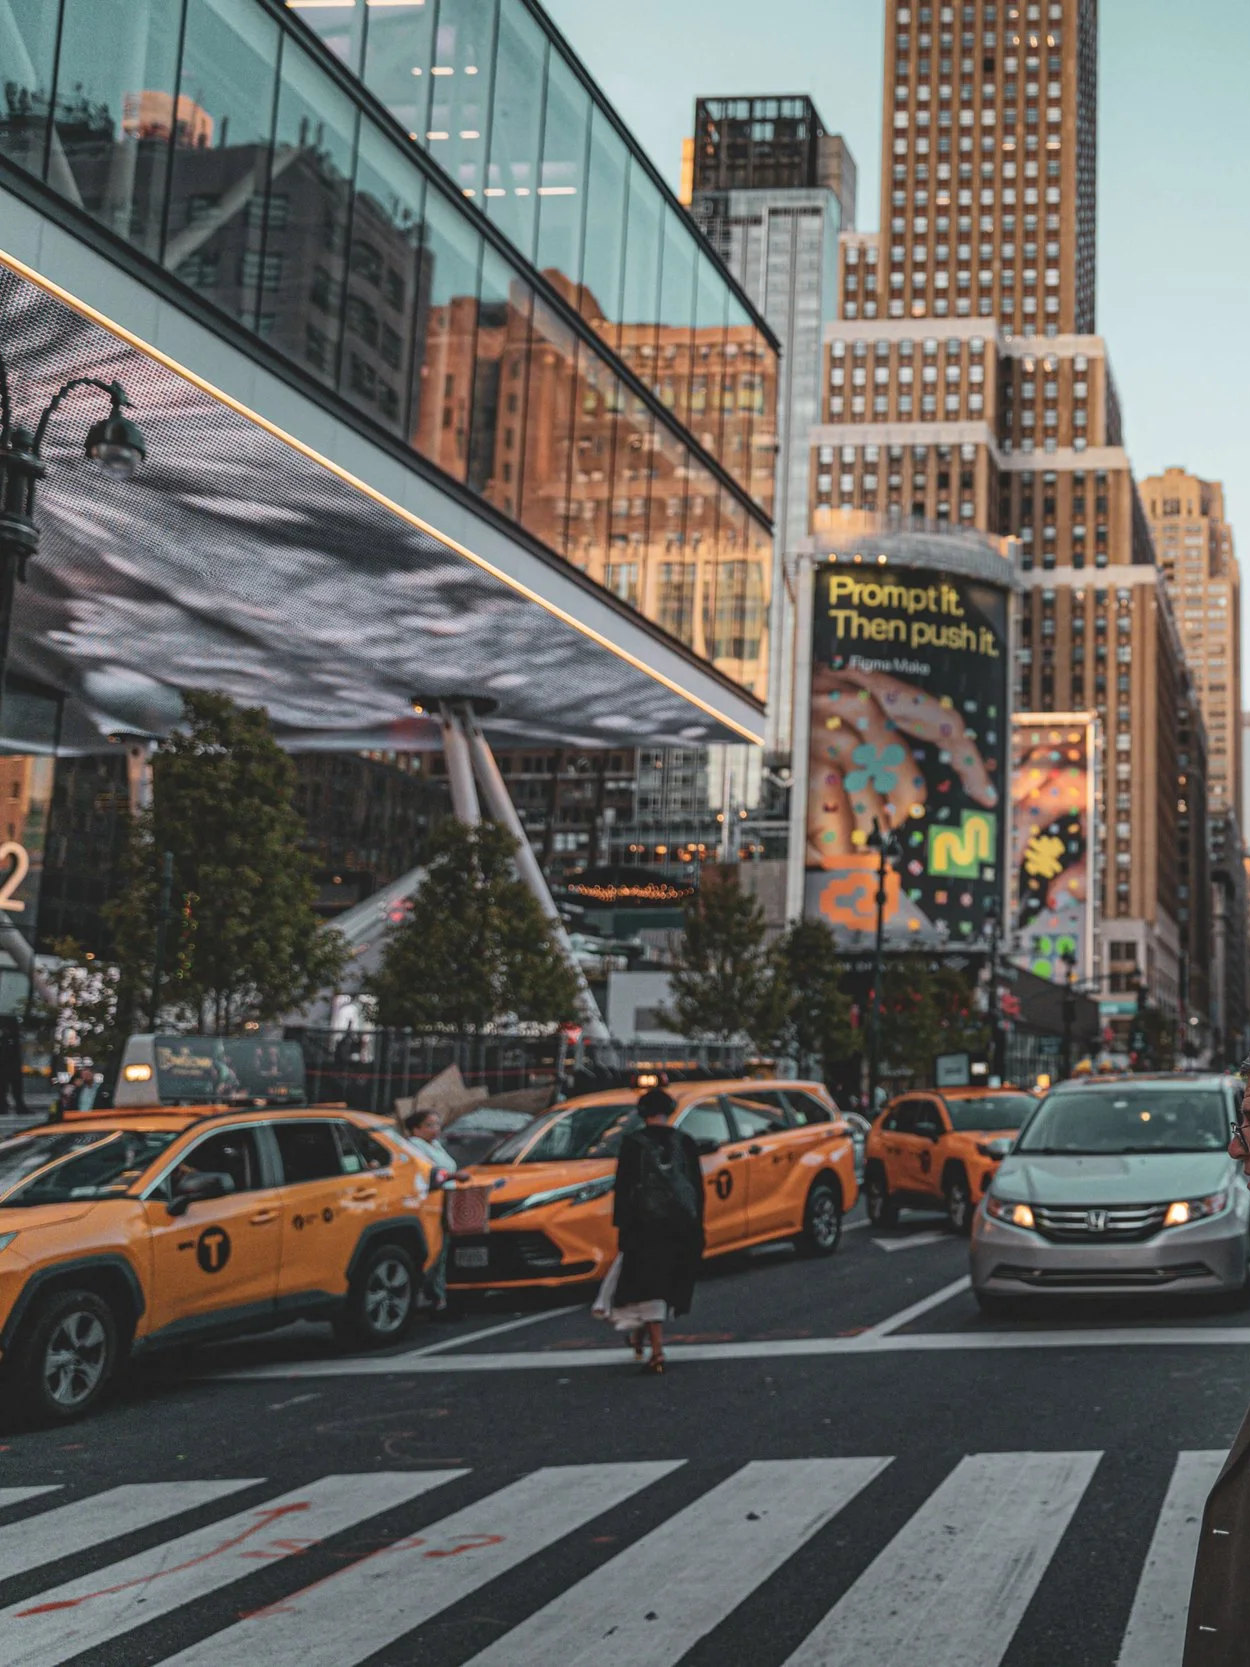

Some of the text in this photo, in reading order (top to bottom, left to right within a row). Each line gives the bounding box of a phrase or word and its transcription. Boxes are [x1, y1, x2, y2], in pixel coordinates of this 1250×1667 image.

[829, 575, 965, 617] Prompt it.
[828, 609, 1000, 658] Then push it.
[850, 654, 931, 676] Figma Make
[203, 1233, 224, 1268] T
